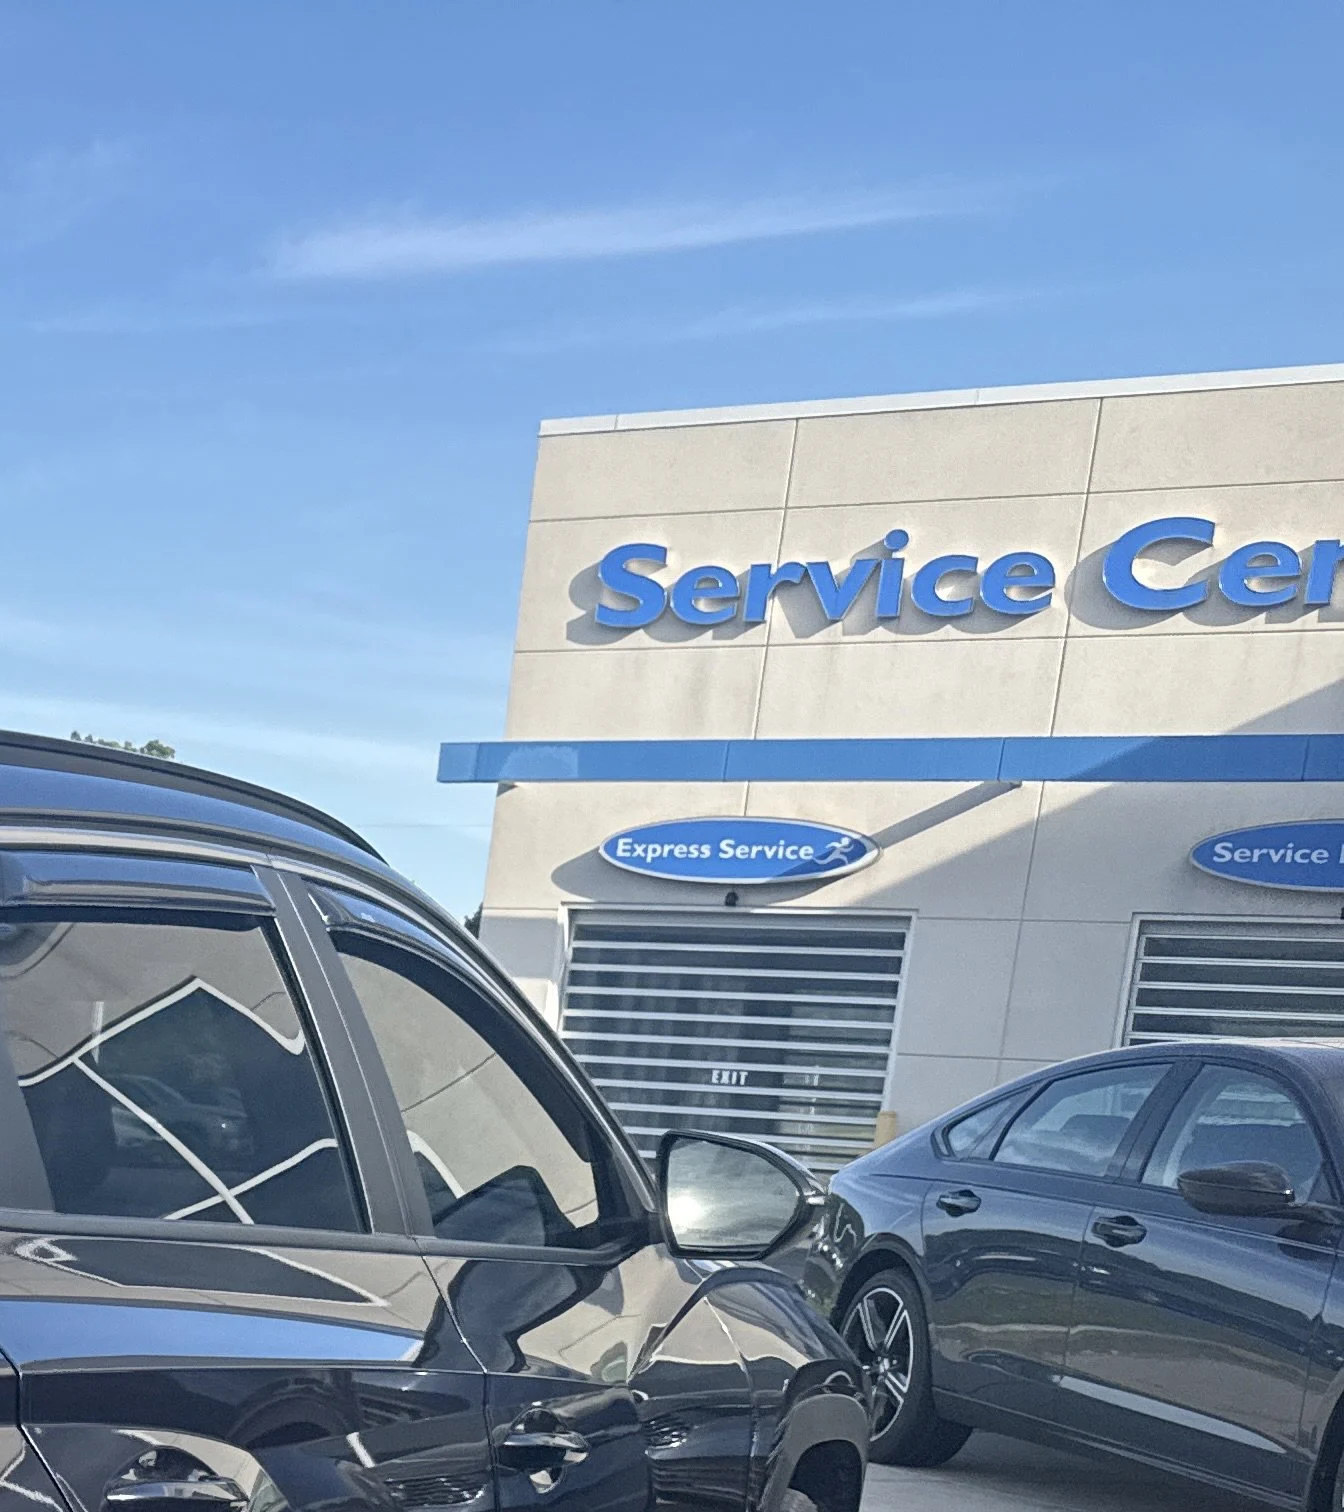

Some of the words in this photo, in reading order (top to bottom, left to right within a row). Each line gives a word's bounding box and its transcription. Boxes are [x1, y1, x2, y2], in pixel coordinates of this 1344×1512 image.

[594, 528, 1056, 628] Service
[616, 838, 710, 863] Express
[719, 839, 814, 861] Service
[1213, 842, 1330, 864] Service
[712, 1070, 748, 1085] EXIT
